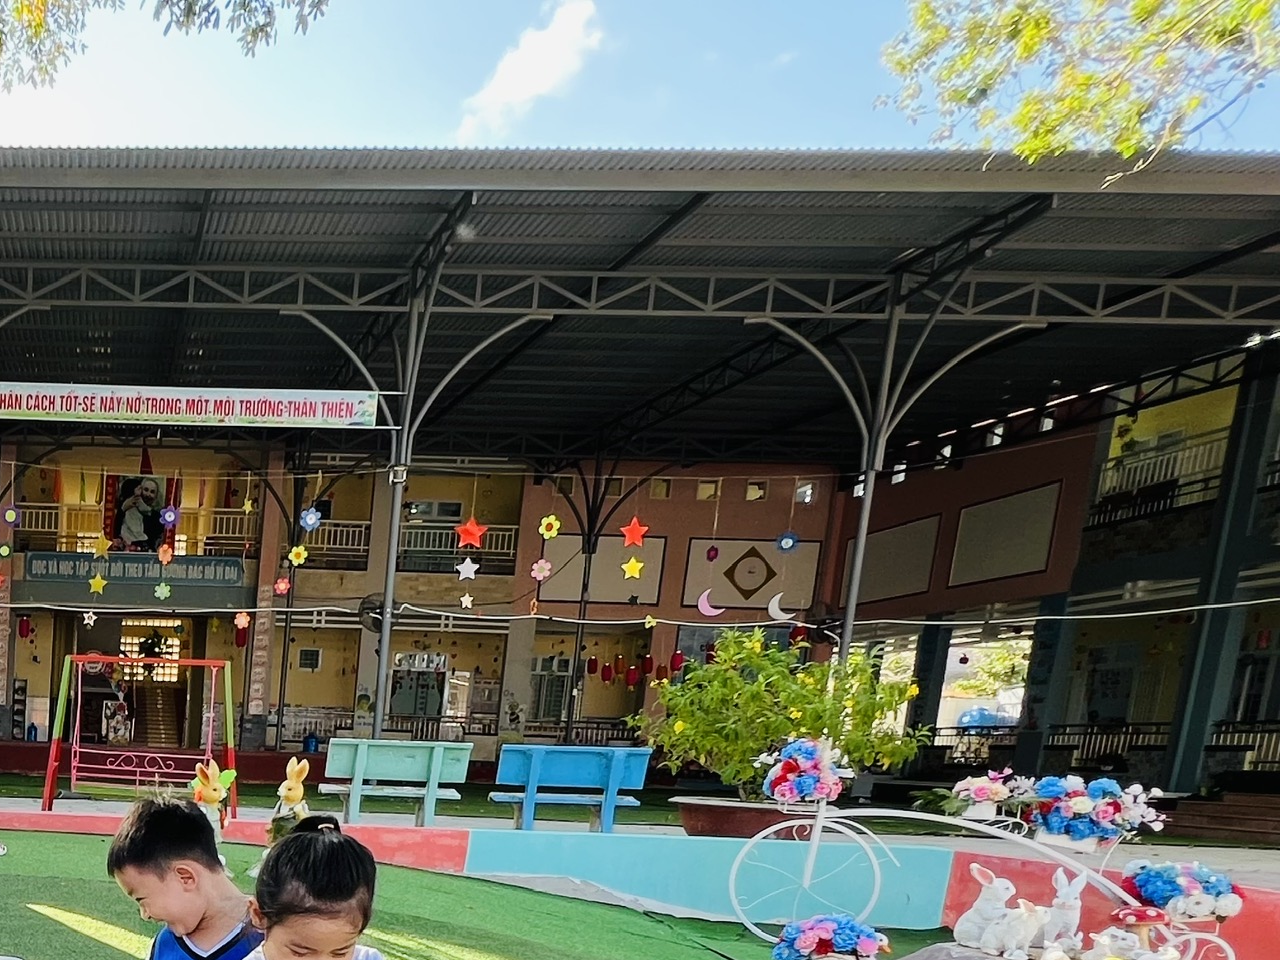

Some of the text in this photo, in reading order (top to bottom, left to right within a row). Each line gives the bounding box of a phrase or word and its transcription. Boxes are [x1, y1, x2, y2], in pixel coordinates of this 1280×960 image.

[25, 390, 56, 412] CÁCH
[145, 397, 182, 415] TRONG
[185, 395, 210, 420] MỘT
[213, 395, 235, 417] MÔI
